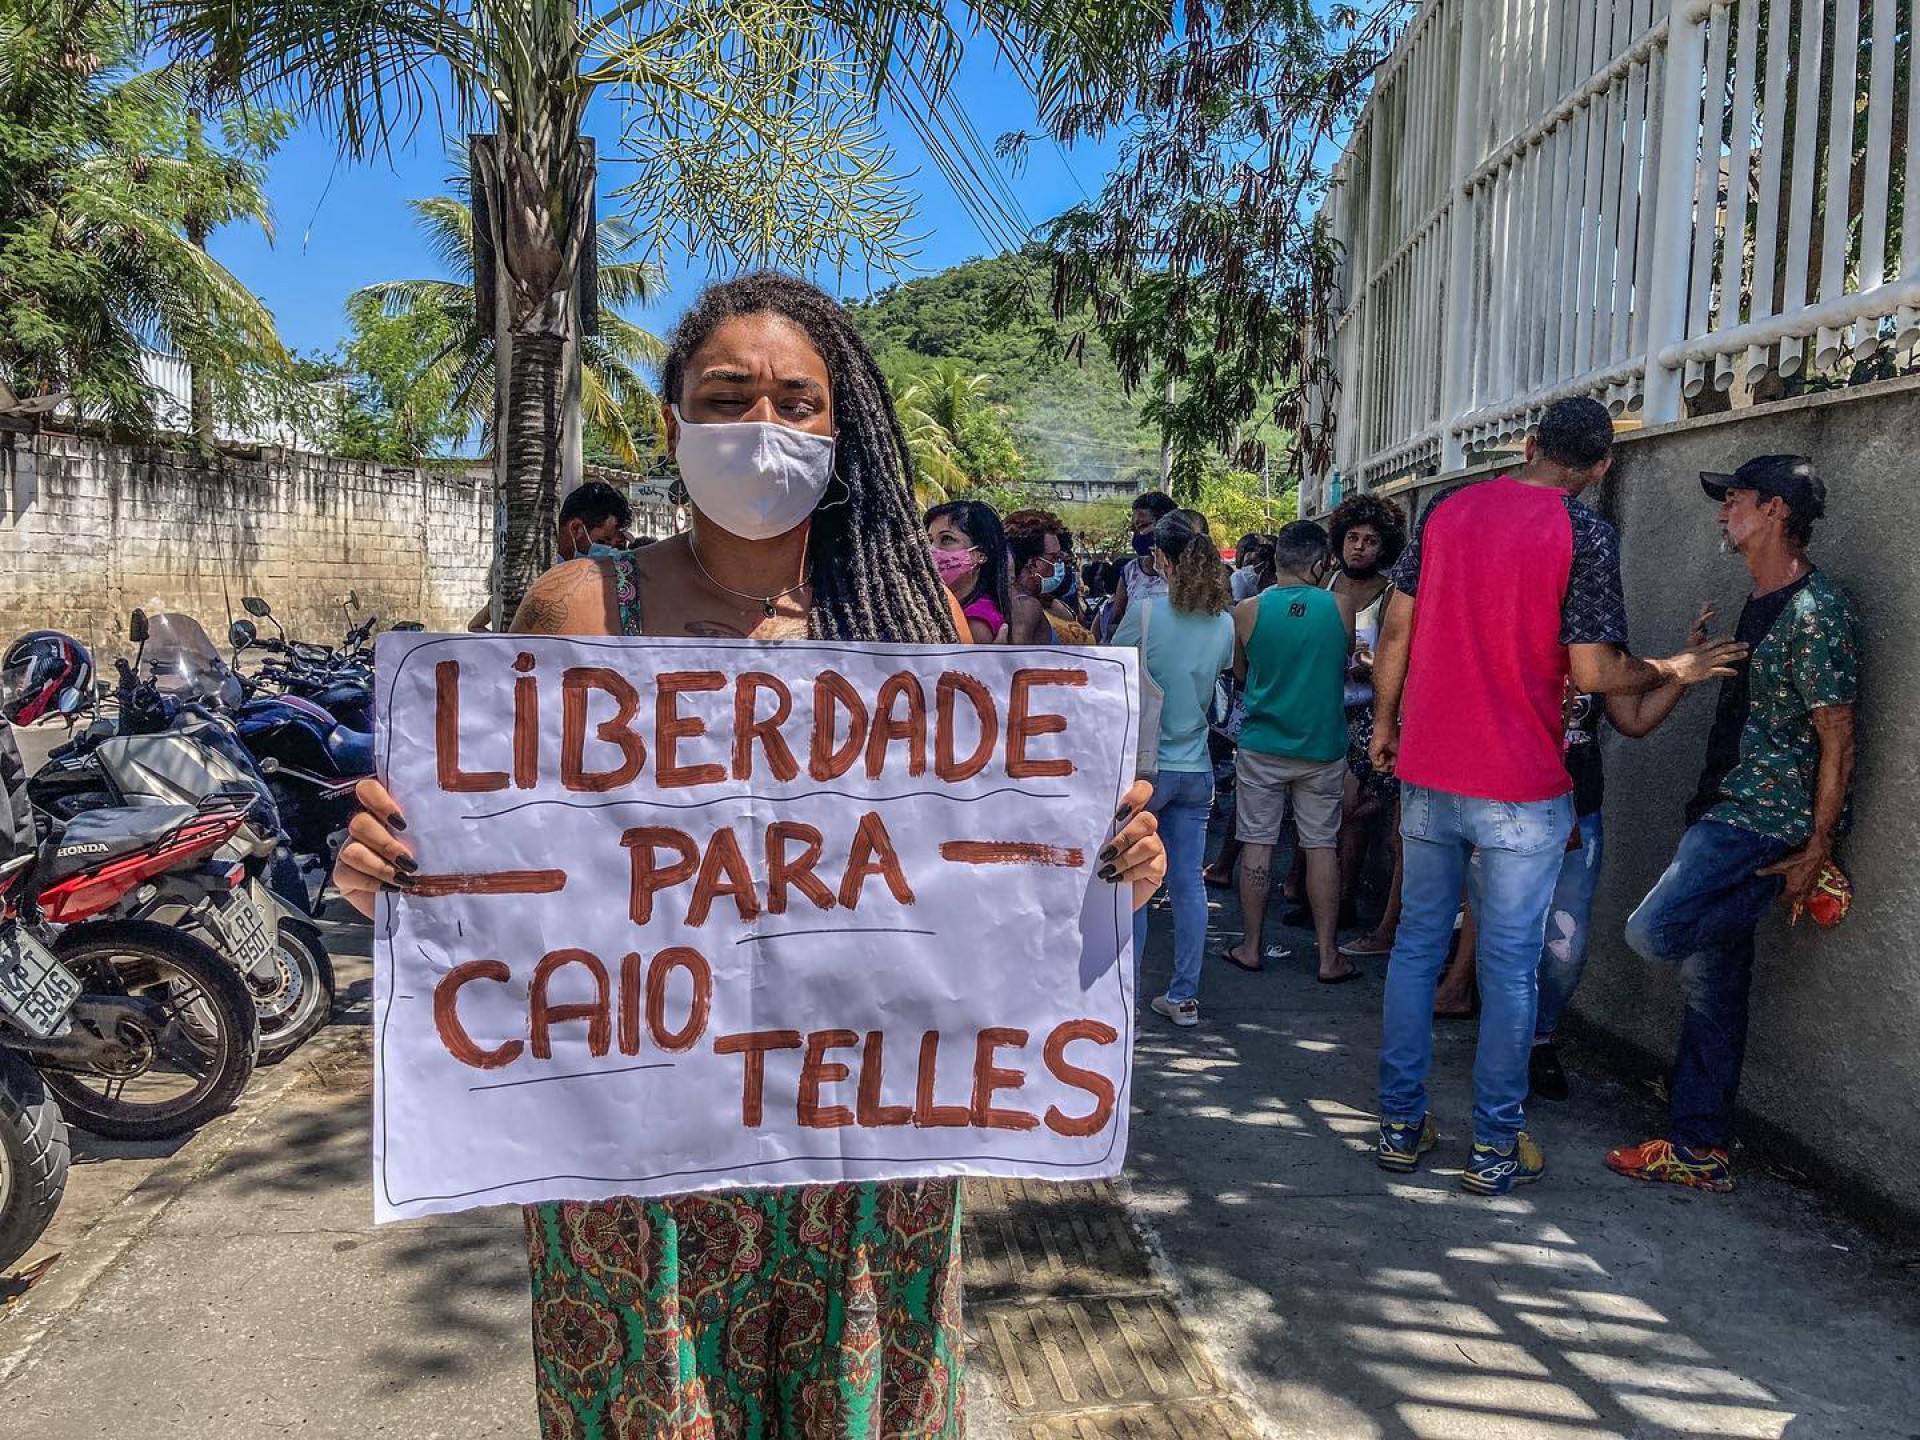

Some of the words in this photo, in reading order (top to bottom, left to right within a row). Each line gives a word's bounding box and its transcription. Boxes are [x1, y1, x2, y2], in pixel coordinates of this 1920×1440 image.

[56, 843, 110, 857] HONDA
[620, 811, 915, 926] PARA
[240, 928, 269, 967] 9501
[24, 970, 74, 1026] 5846
[433, 946, 713, 1070] CAIO
[713, 1018, 1119, 1138] TELLES
